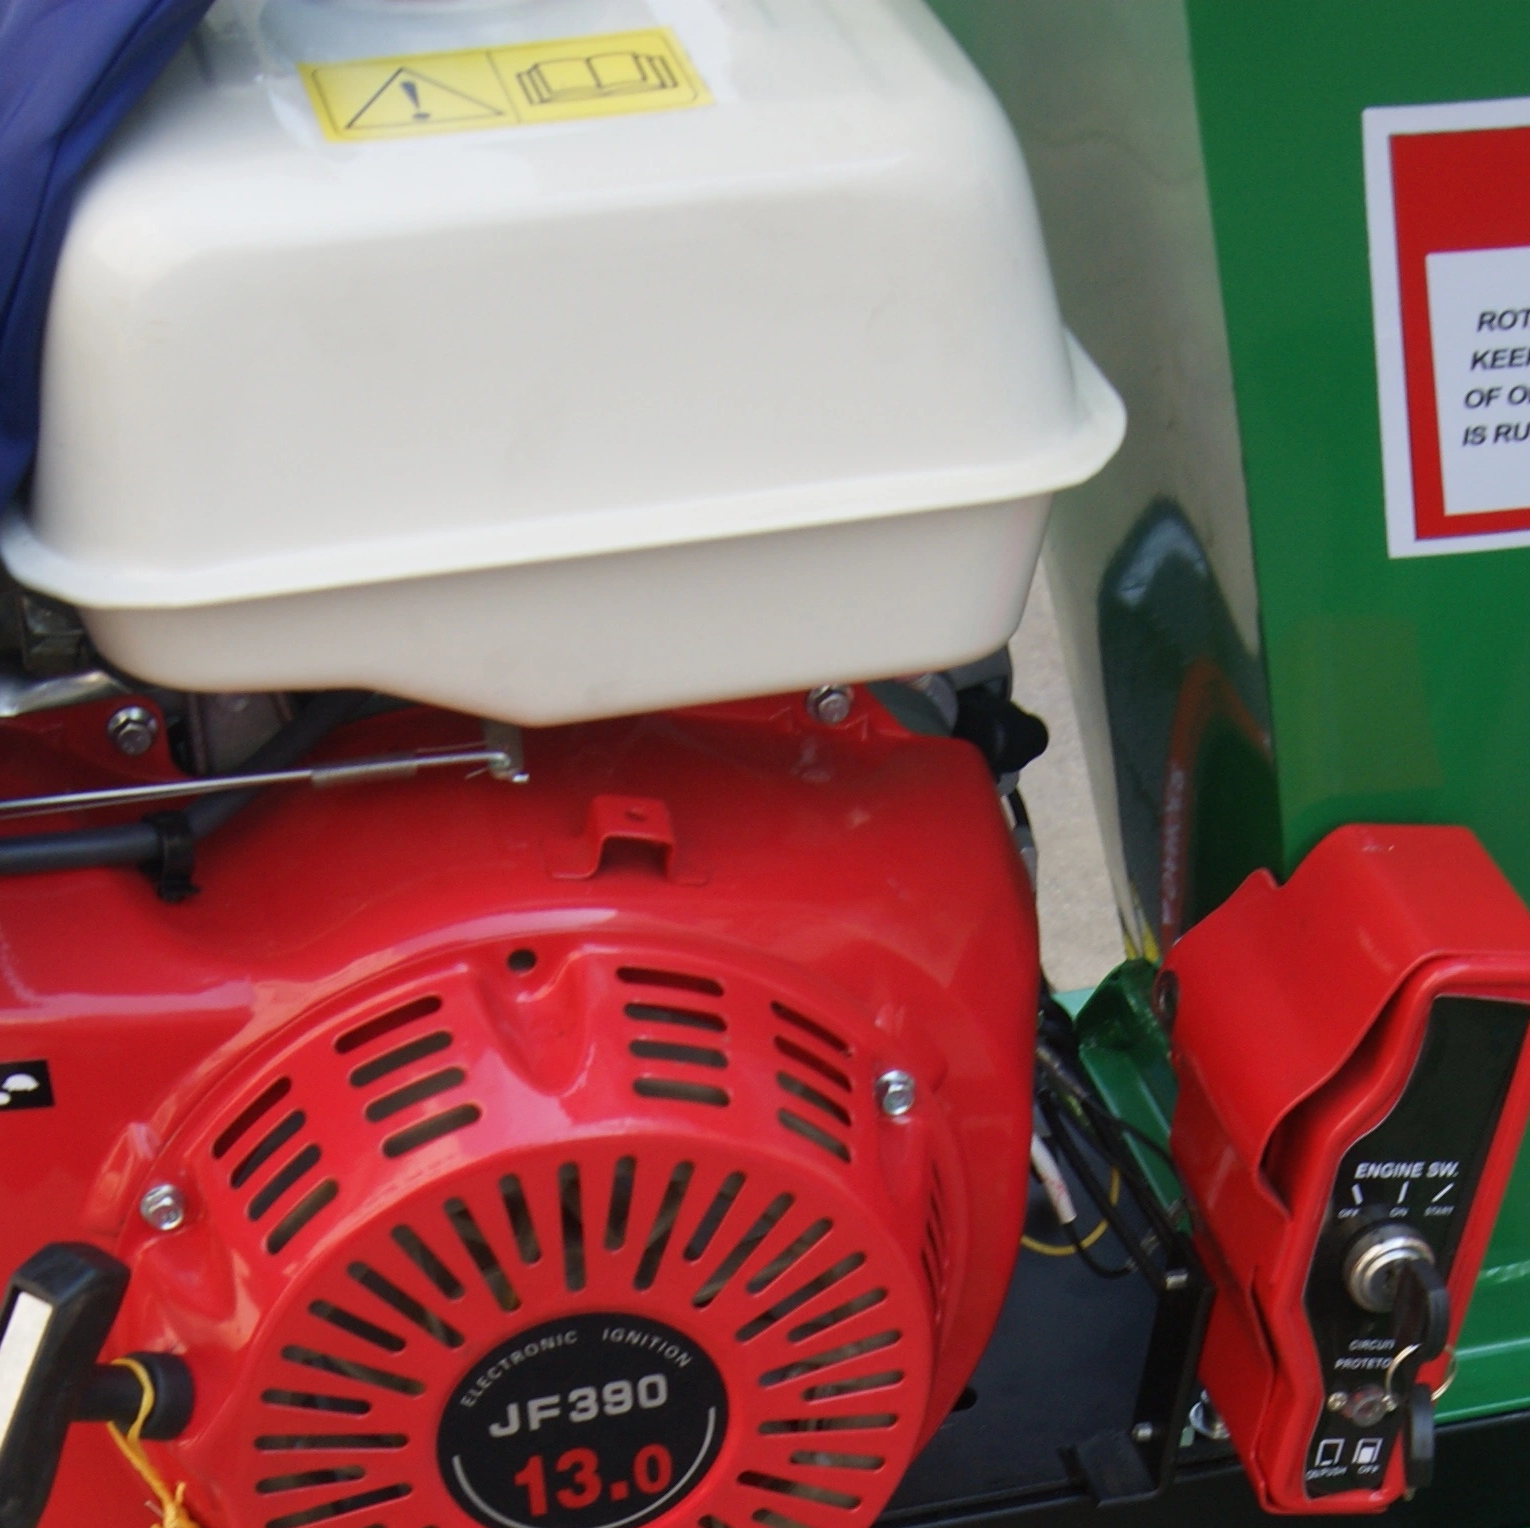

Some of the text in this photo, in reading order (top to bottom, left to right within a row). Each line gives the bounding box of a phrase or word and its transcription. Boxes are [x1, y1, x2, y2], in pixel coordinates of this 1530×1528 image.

[1463, 388, 1503, 411] OF
[1462, 428, 1488, 447] IS
[1354, 1161, 1459, 1179] ENGINE SW.
[1337, 1207, 1361, 1219] OFF
[1389, 1206, 1409, 1218] ON
[1424, 1205, 1455, 1217] START
[460, 1327, 692, 1408] ELECTRONIC IGNITION
[1334, 1357, 1393, 1370] PROTETO
[488, 1372, 669, 1438] JF390
[1357, 1464, 1380, 1475] OFF
[514, 1444, 674, 1518] 13.0
